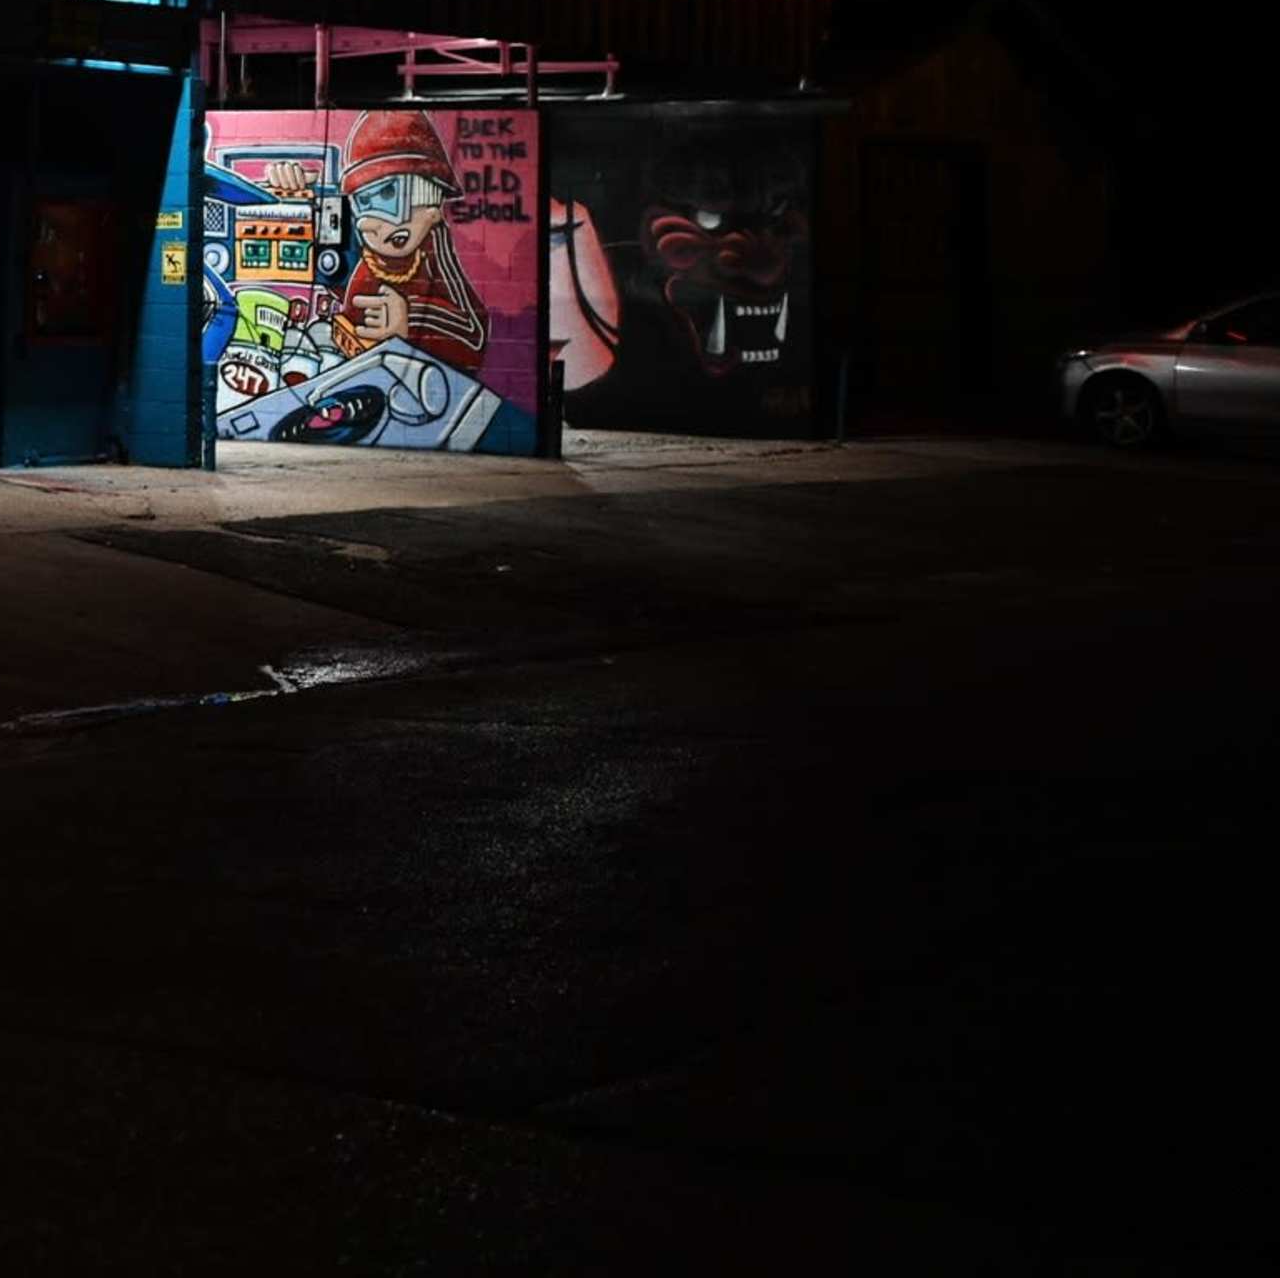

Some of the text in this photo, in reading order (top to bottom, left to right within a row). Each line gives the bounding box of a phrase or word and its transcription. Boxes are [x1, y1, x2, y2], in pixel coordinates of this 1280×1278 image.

[457, 118, 515, 138] BACK
[458, 141, 528, 160] TO THE
[463, 165, 522, 194] OLD
[224, 364, 264, 394] 247
